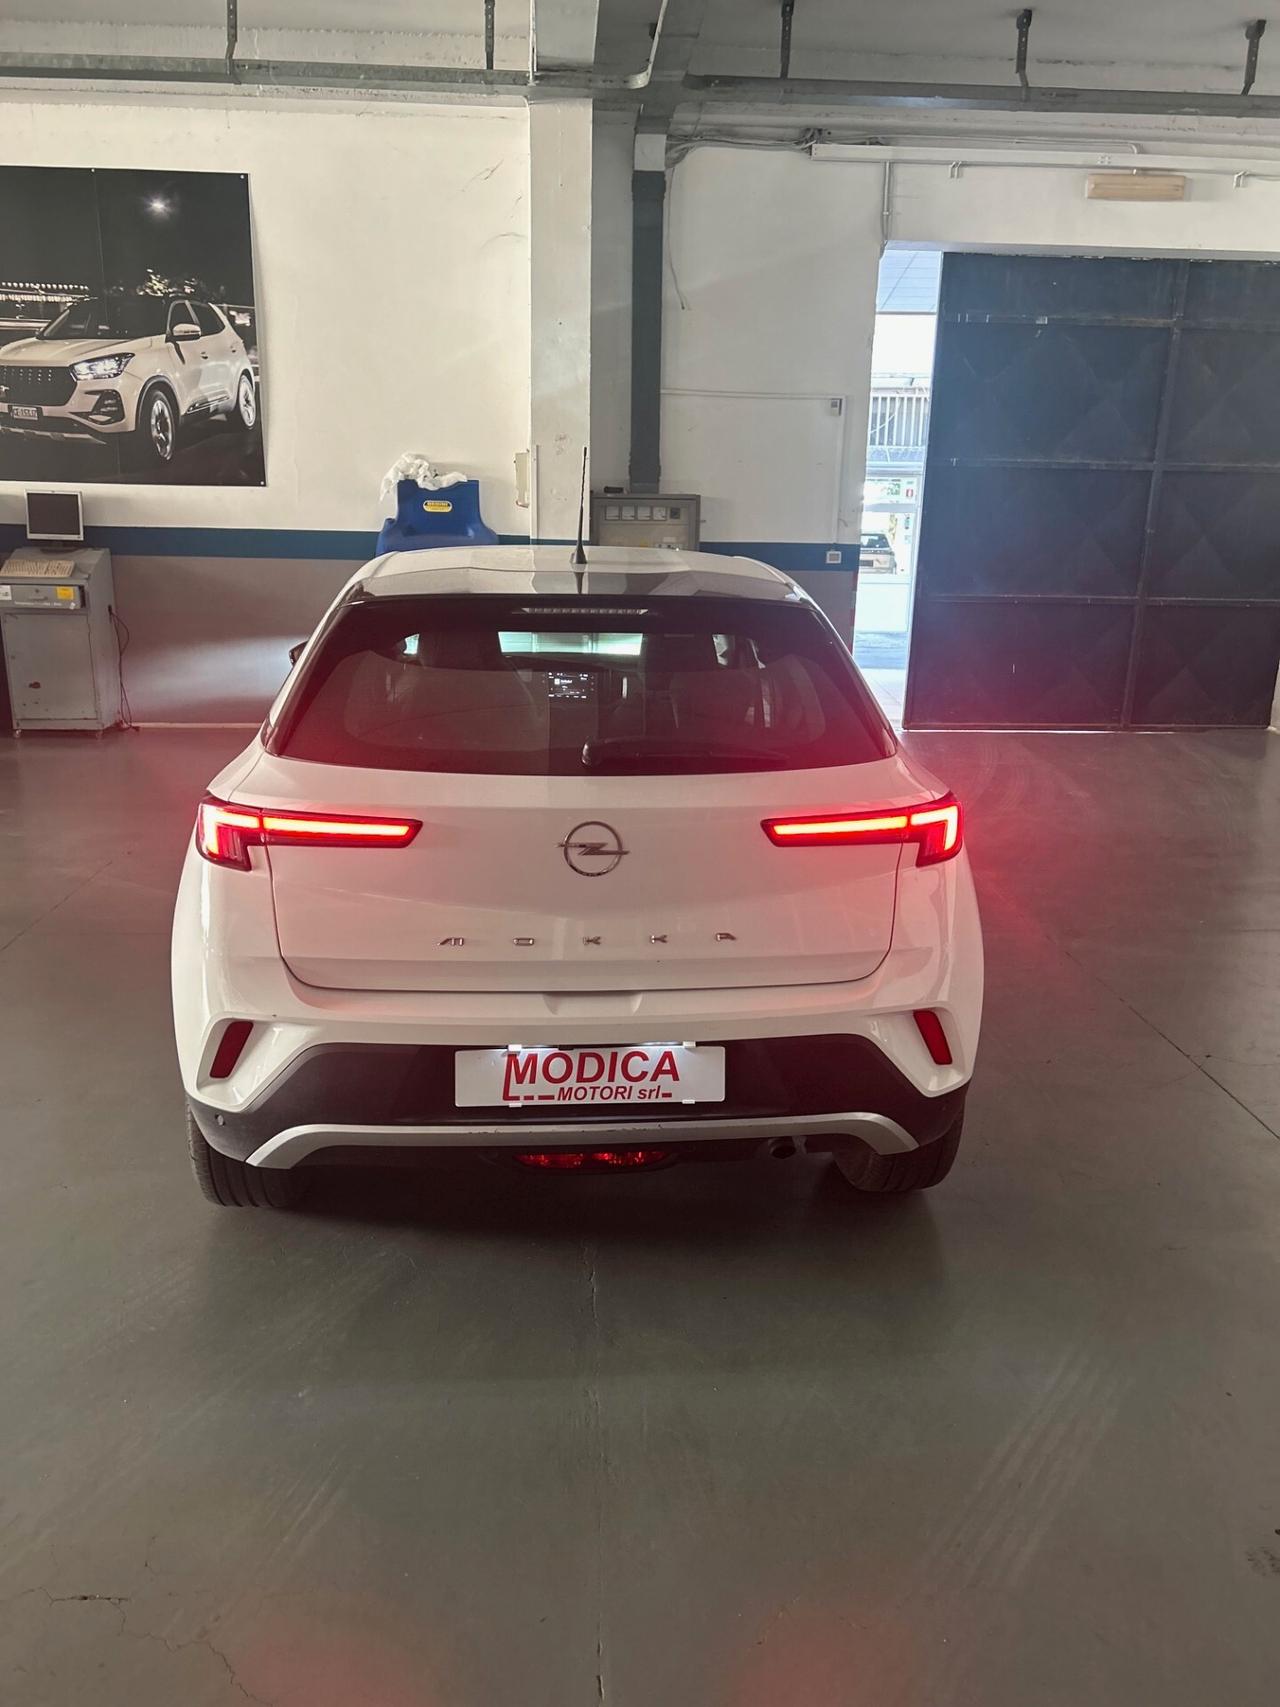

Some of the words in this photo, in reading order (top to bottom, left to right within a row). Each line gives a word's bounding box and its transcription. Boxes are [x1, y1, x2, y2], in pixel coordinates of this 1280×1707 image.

[504, 1050, 680, 1085] MODICA
[557, 1086, 633, 1101] MOTORI
[637, 1085, 661, 1100] srl
